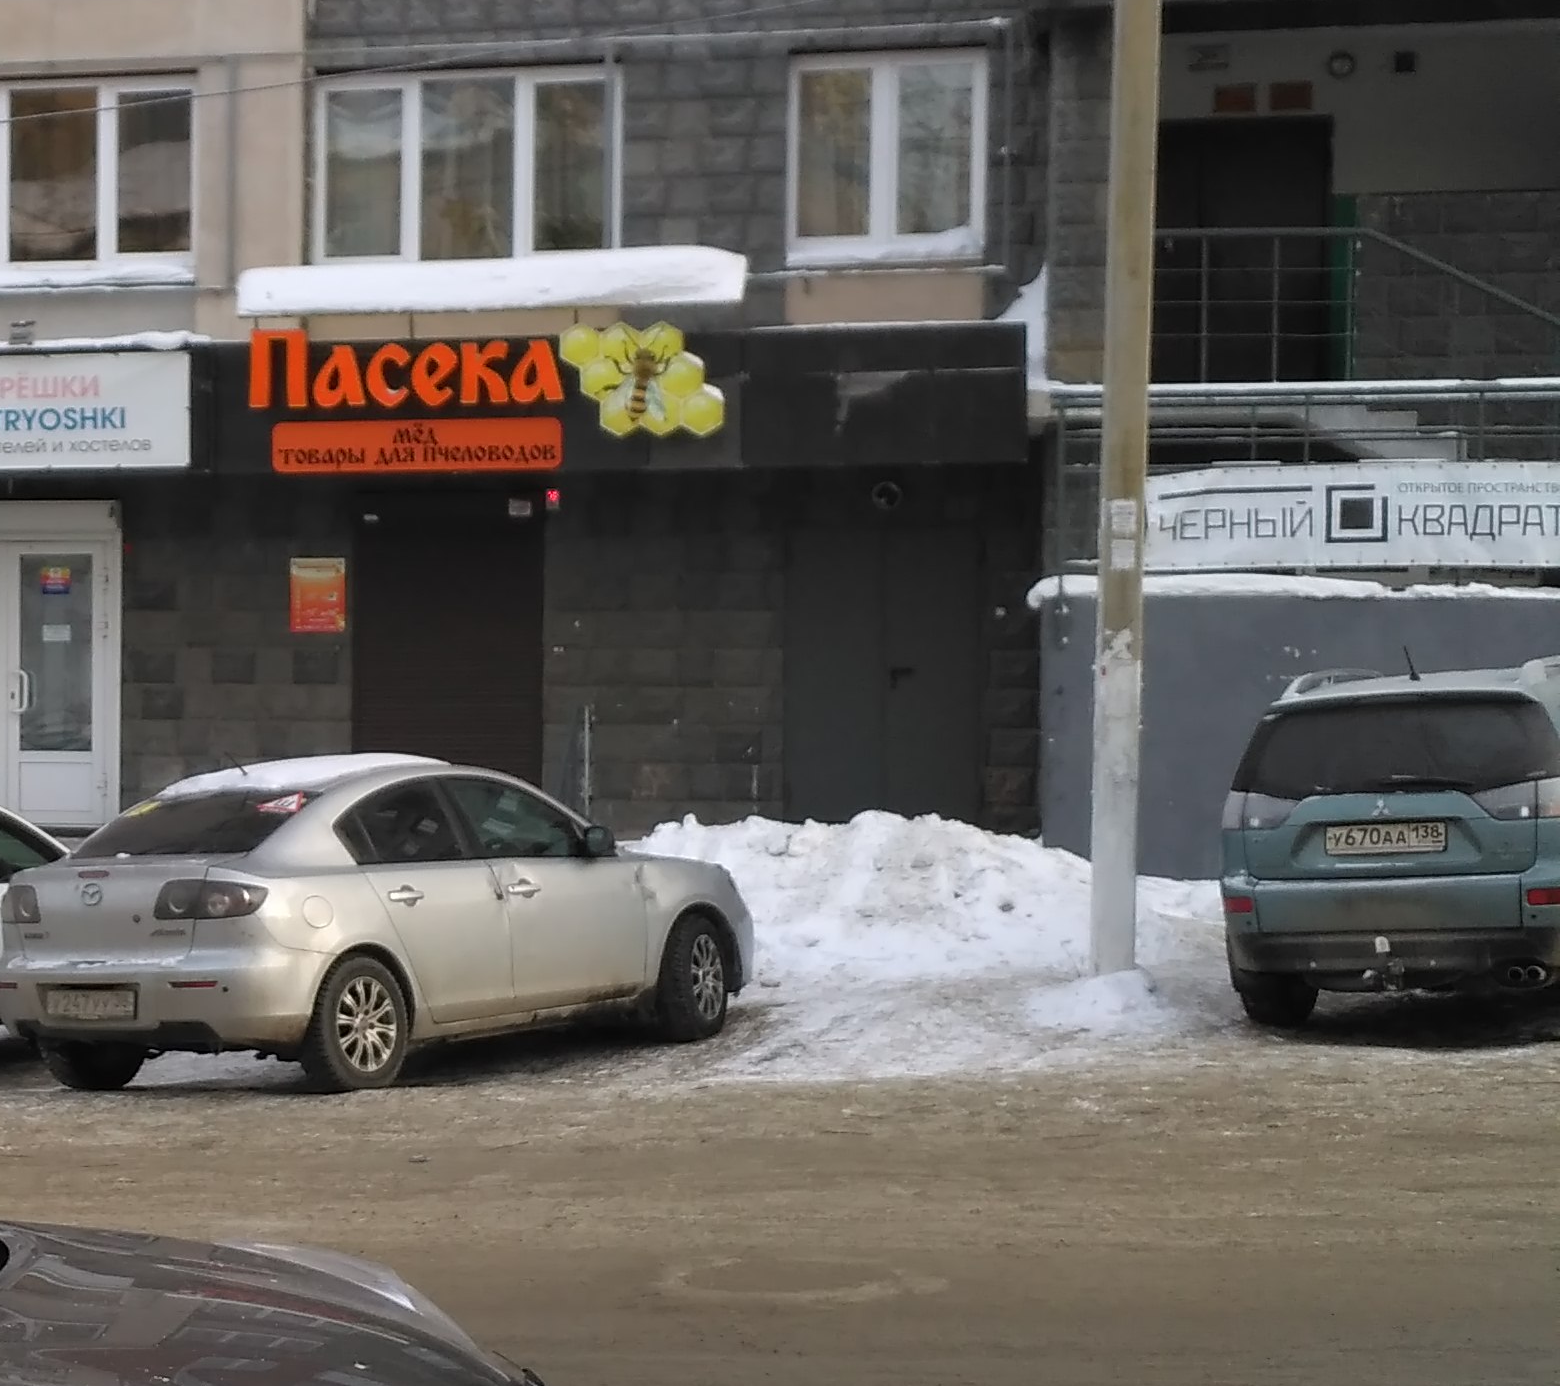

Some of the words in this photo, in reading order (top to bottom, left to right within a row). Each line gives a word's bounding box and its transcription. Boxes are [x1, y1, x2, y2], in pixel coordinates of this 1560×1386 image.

[248, 328, 564, 409] Пасека
[52, 441, 63, 453] и
[68, 438, 152, 453] хостелов
[1397, 481, 1464, 494] ОТКРЫТОЕ
[1158, 500, 1313, 541] ЧЕРНЫЙ
[1397, 503, 1560, 542] КВАДРАТ
[1332, 827, 1407, 847] У670АА
[1413, 824, 1441, 839] 138
